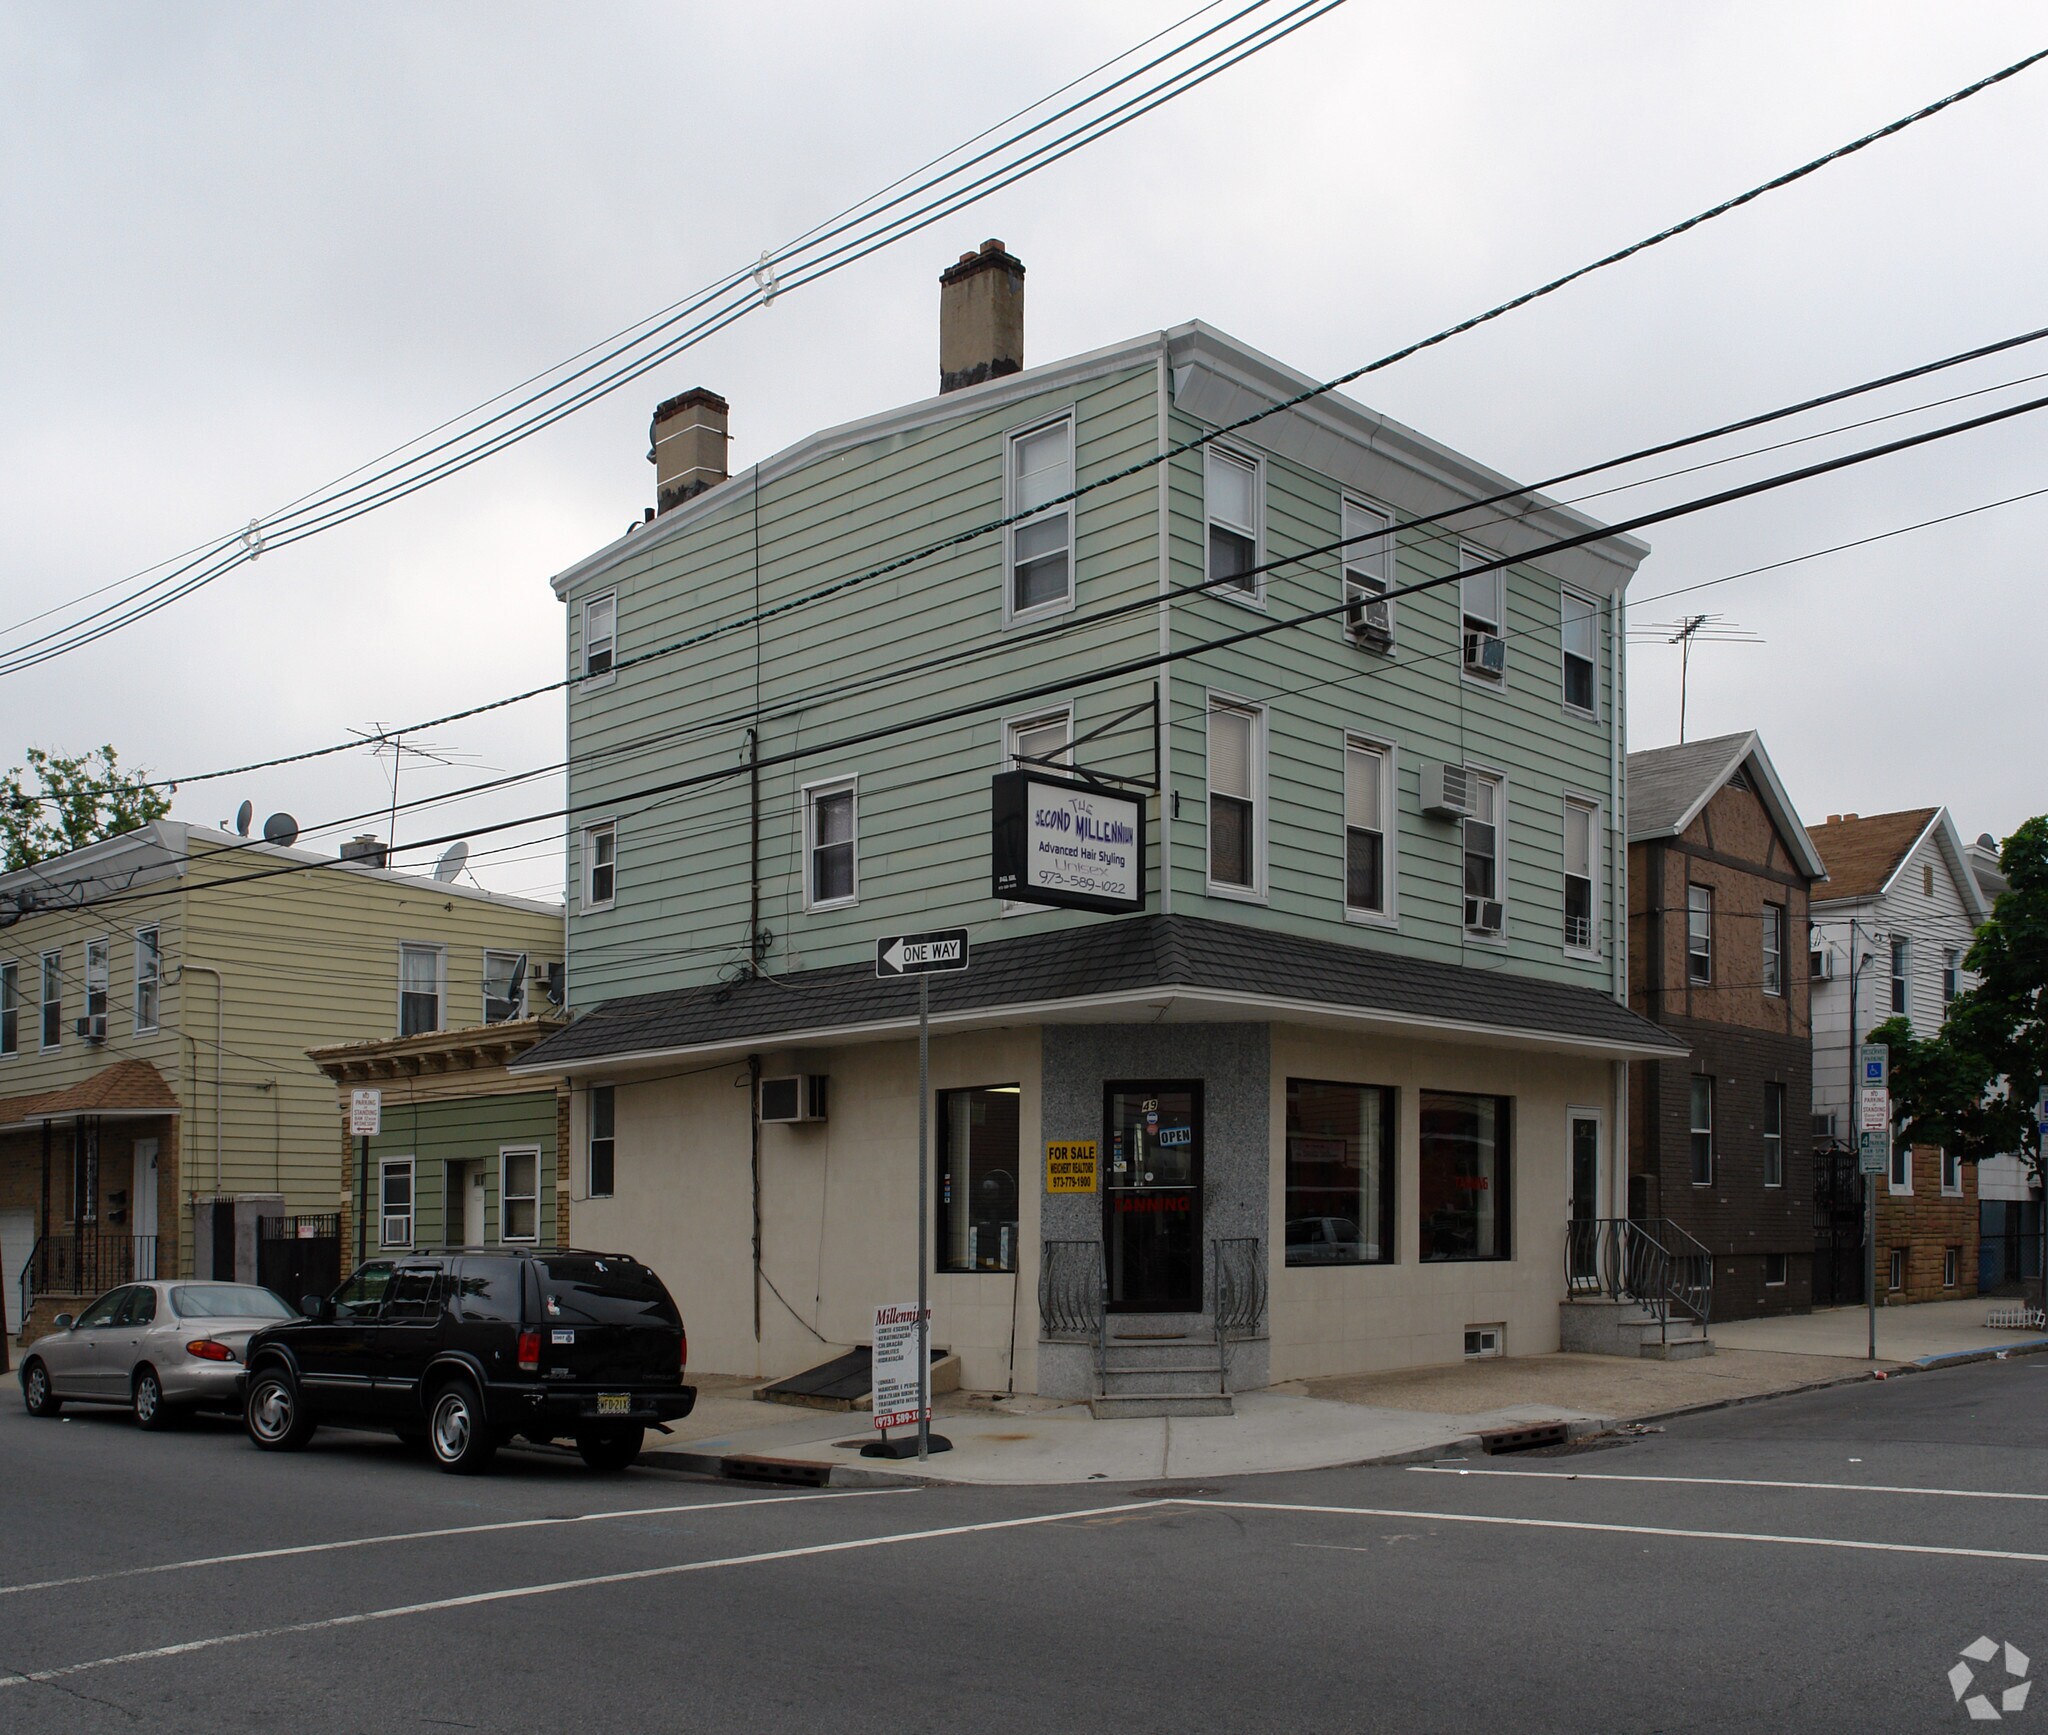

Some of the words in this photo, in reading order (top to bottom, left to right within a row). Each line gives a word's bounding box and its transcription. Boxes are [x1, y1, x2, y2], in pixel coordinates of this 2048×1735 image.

[1068, 798, 1094, 816] THE
[1035, 808, 1070, 832] SECOND
[1076, 815, 1133, 846] MILLENNIUM
[1039, 841, 1078, 857] Advanced
[1081, 848, 1096, 860] Hair
[1099, 851, 1125, 867] Styling
[1039, 870, 1126, 894] 973-589-1022
[904, 945, 927, 961] ONE
[932, 942, 958, 959] WAY
[1142, 1100, 1157, 1111] 49
[1161, 1130, 1189, 1143] OPEN
[1862, 1136, 1868, 1146] 4
[1049, 1147, 1068, 1160] FOR
[1071, 1146, 1094, 1159] SALE
[1051, 1163, 1071, 1173] WEICHERT
[1072, 1163, 1093, 1173] REALTORS
[1115, 1197, 1189, 1212] TANNING
[875, 1416, 894, 1428] (973)
